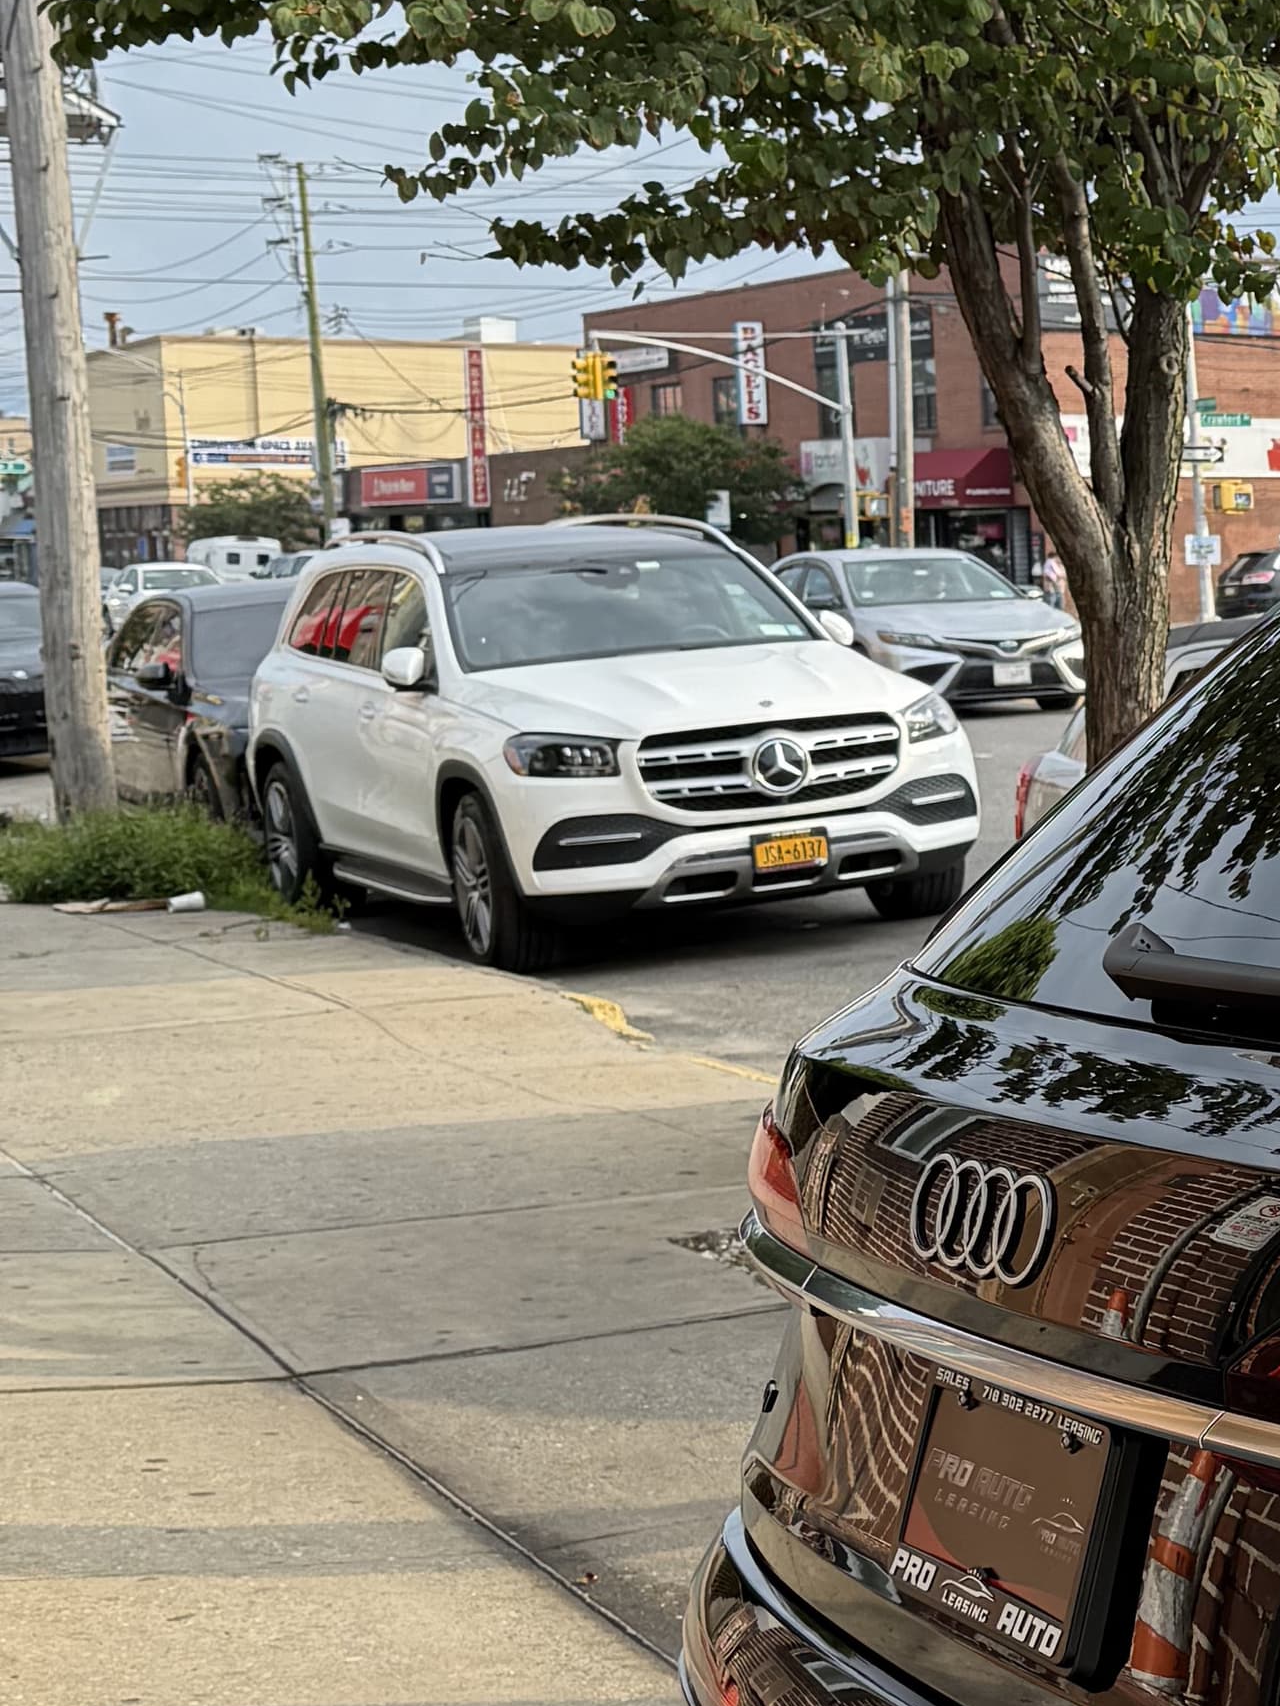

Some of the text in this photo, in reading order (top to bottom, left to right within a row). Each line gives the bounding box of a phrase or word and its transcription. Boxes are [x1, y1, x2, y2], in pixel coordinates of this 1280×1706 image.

[1202, 413, 1242, 425] Crawford
[936, 1367, 971, 1391] SALES
[1001, 1394, 1024, 1412] 902
[1024, 1403, 1054, 1425] 2277
[1057, 1414, 1103, 1445] LEASING
[925, 1447, 1036, 1512] PRO AUTO
[934, 1488, 1012, 1530] LEASING
[889, 1548, 1064, 1658] PRO AUTO
[941, 1589, 989, 1623] LEASING
